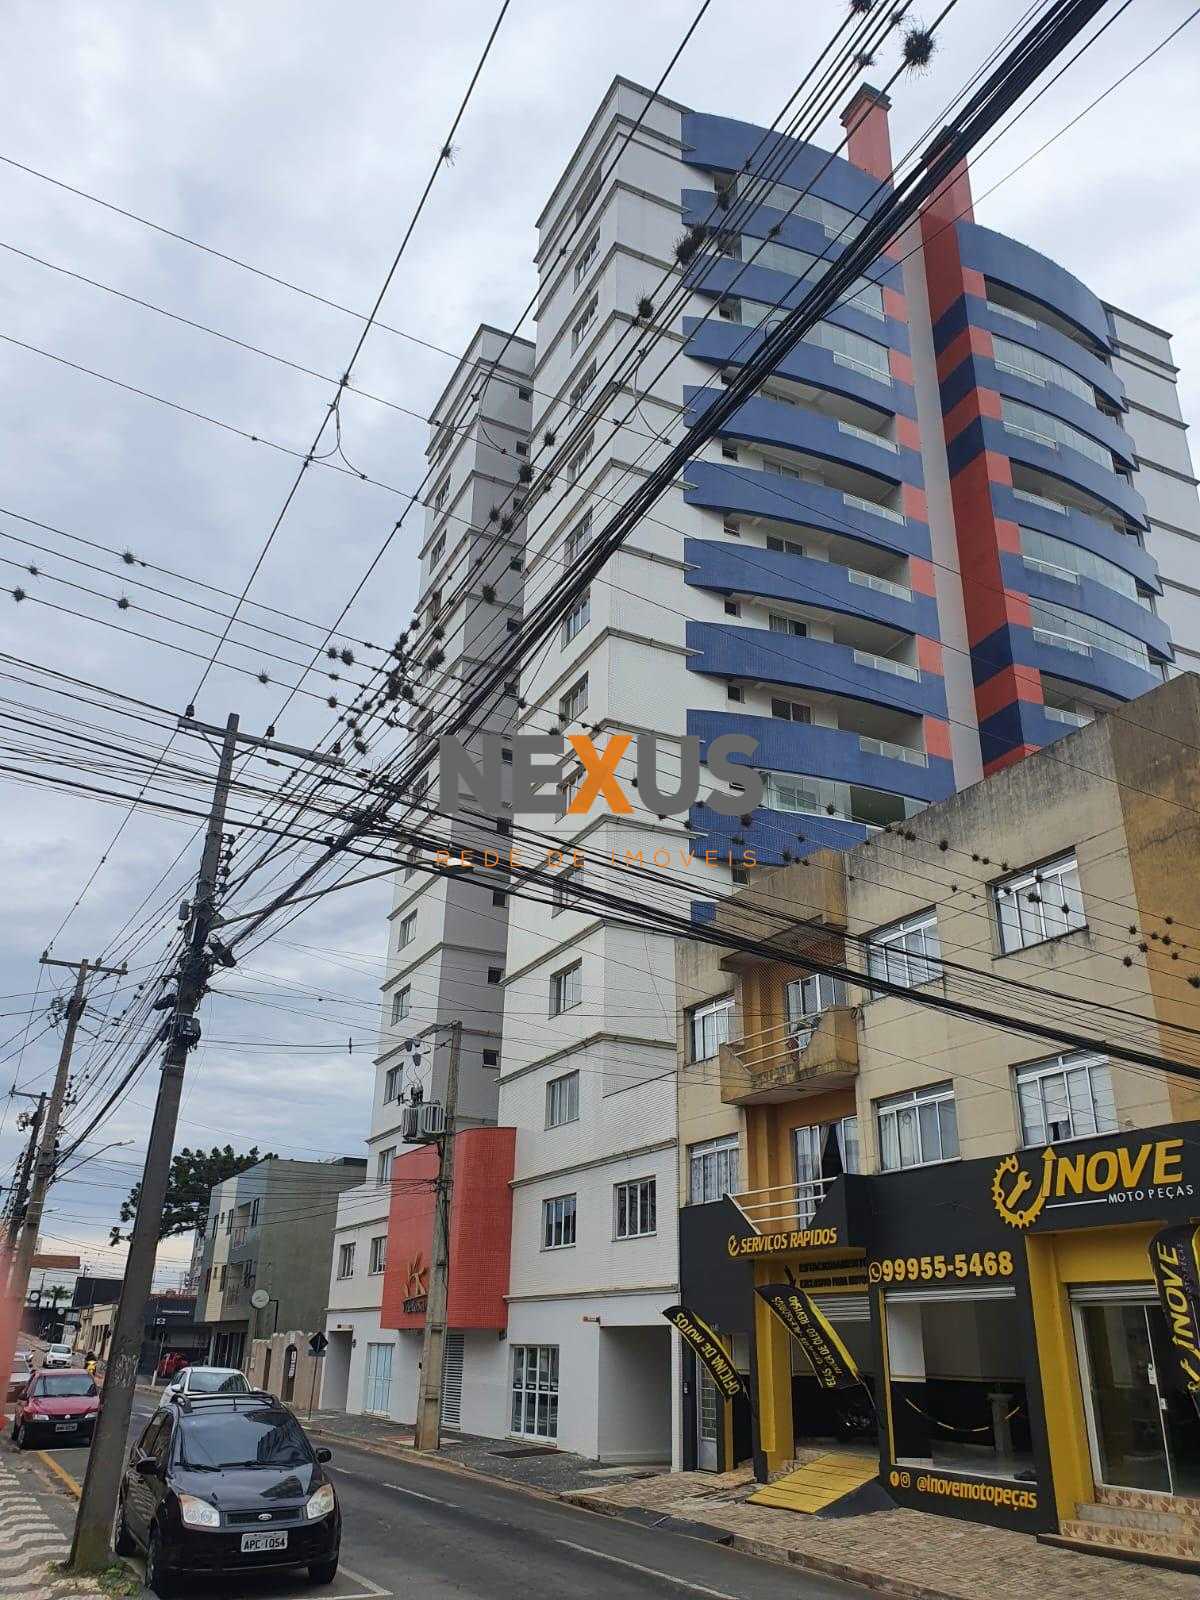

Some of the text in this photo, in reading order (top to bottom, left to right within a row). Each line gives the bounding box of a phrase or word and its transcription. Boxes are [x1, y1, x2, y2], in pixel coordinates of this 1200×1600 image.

[1108, 1184, 1194, 1205] MOTO PEÇAS
[740, 1233, 789, 1255] SERVIÇOS
[881, 1250, 1014, 1282] 99955-5468
[701, 1342, 718, 1359] DE
[711, 1354, 740, 1396] OFICINA
